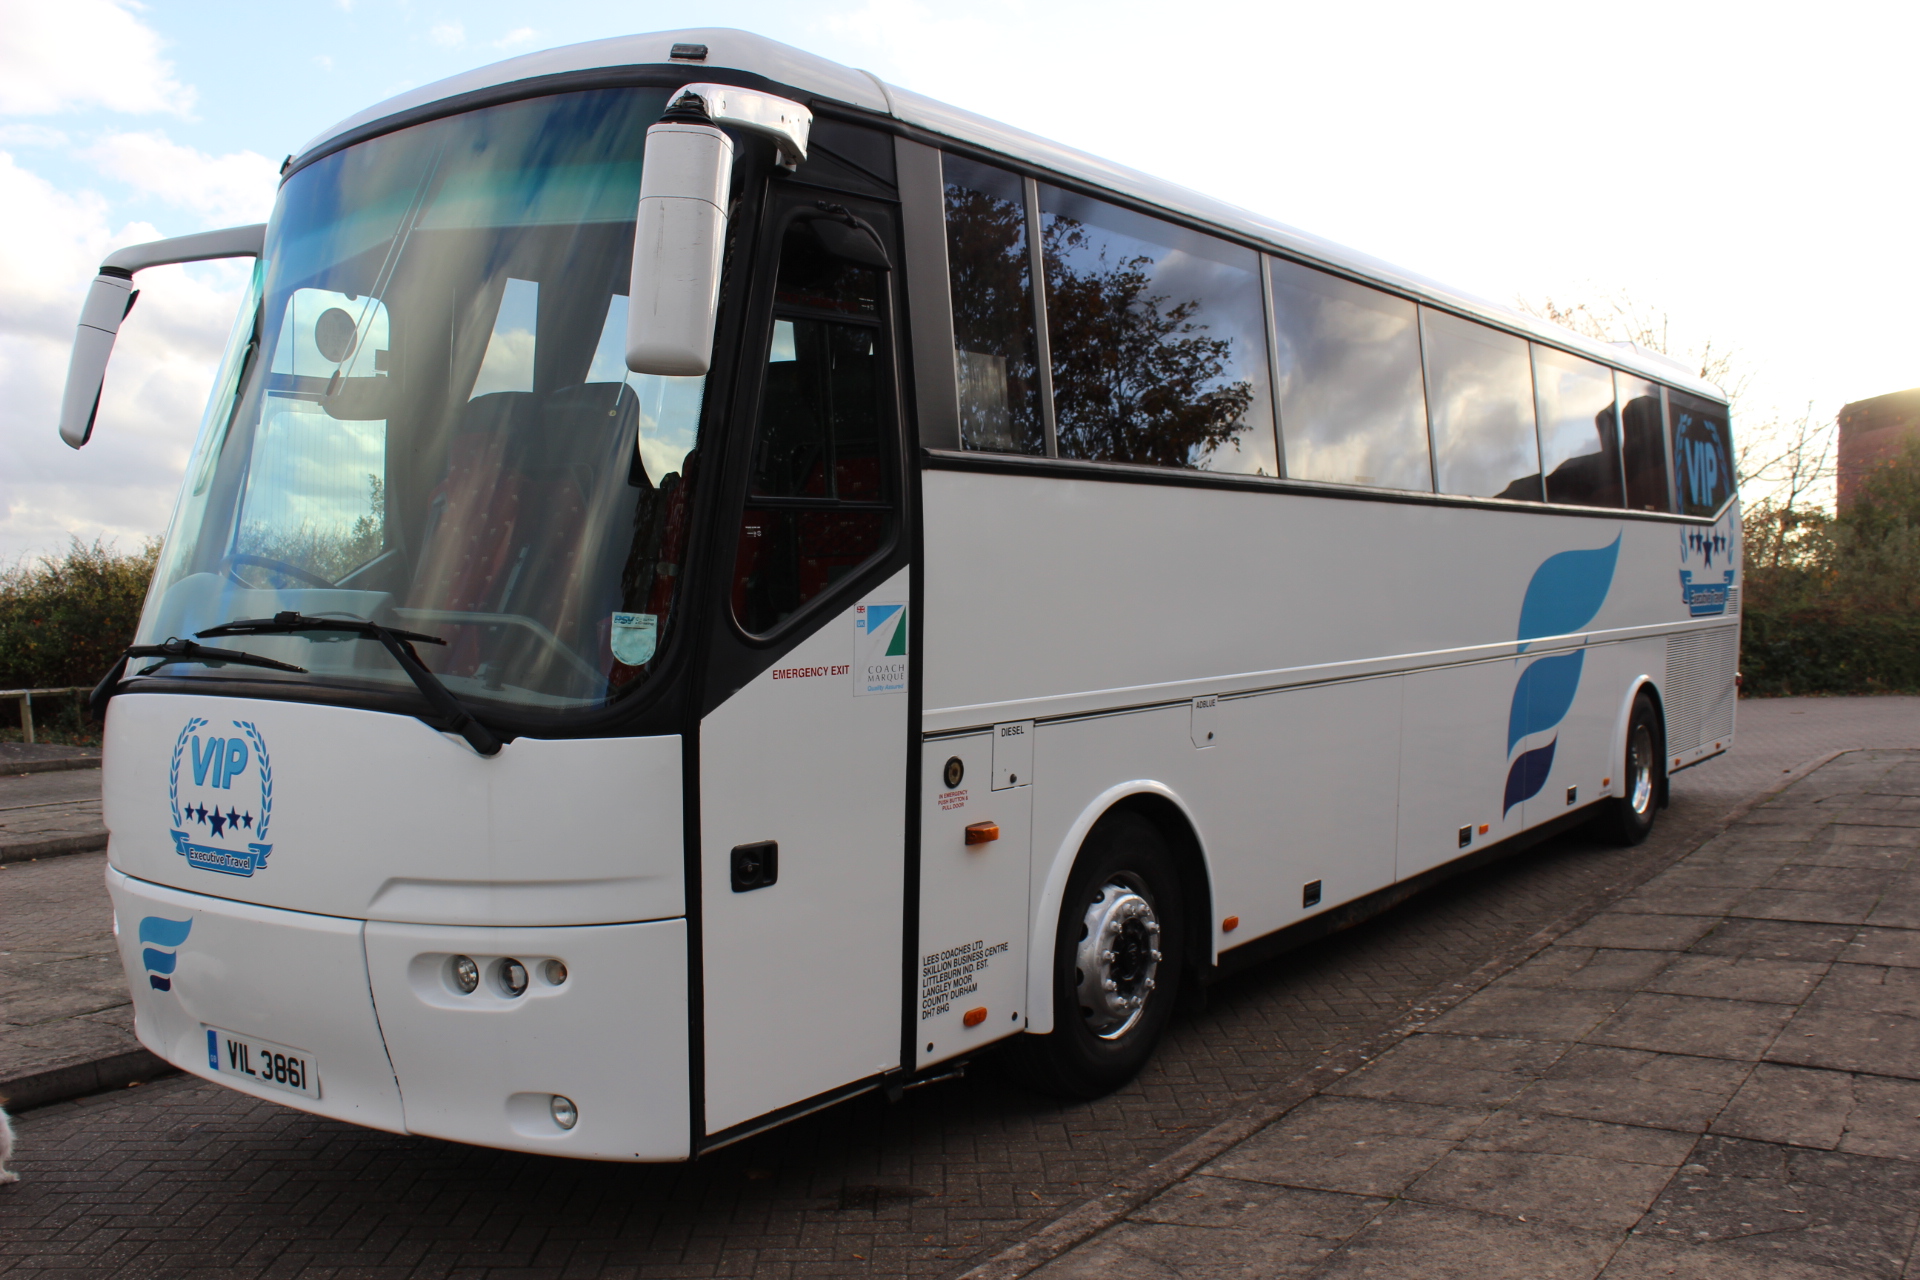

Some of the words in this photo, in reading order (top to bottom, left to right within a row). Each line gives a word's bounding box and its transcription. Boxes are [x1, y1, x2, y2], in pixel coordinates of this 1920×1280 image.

[1684, 437, 1718, 507] VIP
[772, 667, 829, 680] EMERGENCY
[831, 665, 850, 676] EXIT
[867, 664, 905, 674] COACH
[867, 673, 904, 684] MARQUE
[1196, 699, 1216, 709] ADBLUE
[1001, 725, 1024, 737] DIESEL
[191, 735, 249, 790] VIP
[944, 790, 968, 798] EMERGENCY
[189, 849, 225, 865] Executive
[226, 854, 251, 869] Travel
[922, 953, 940, 967] LEES
[940, 944, 972, 961] COACHES
[972, 940, 983, 951] LTD
[922, 962, 953, 978] SKILLION
[953, 951, 984, 968] BUSINESS
[984, 942, 1008, 957] CENTRE
[922, 968, 961, 988] LITTLEBURN
[962, 963, 975, 976] IND.
[976, 959, 989, 971] EST.
[922, 983, 952, 999] LANGLEY
[953, 974, 972, 987] MOOR
[922, 993, 949, 1009] COUNTY
[950, 983, 978, 1000] DURHAM
[922, 1009, 936, 1020] DH7
[936, 1003, 950, 1015] 8HG
[227, 1039, 256, 1076] VIL
[261, 1049, 306, 1090] 3861
